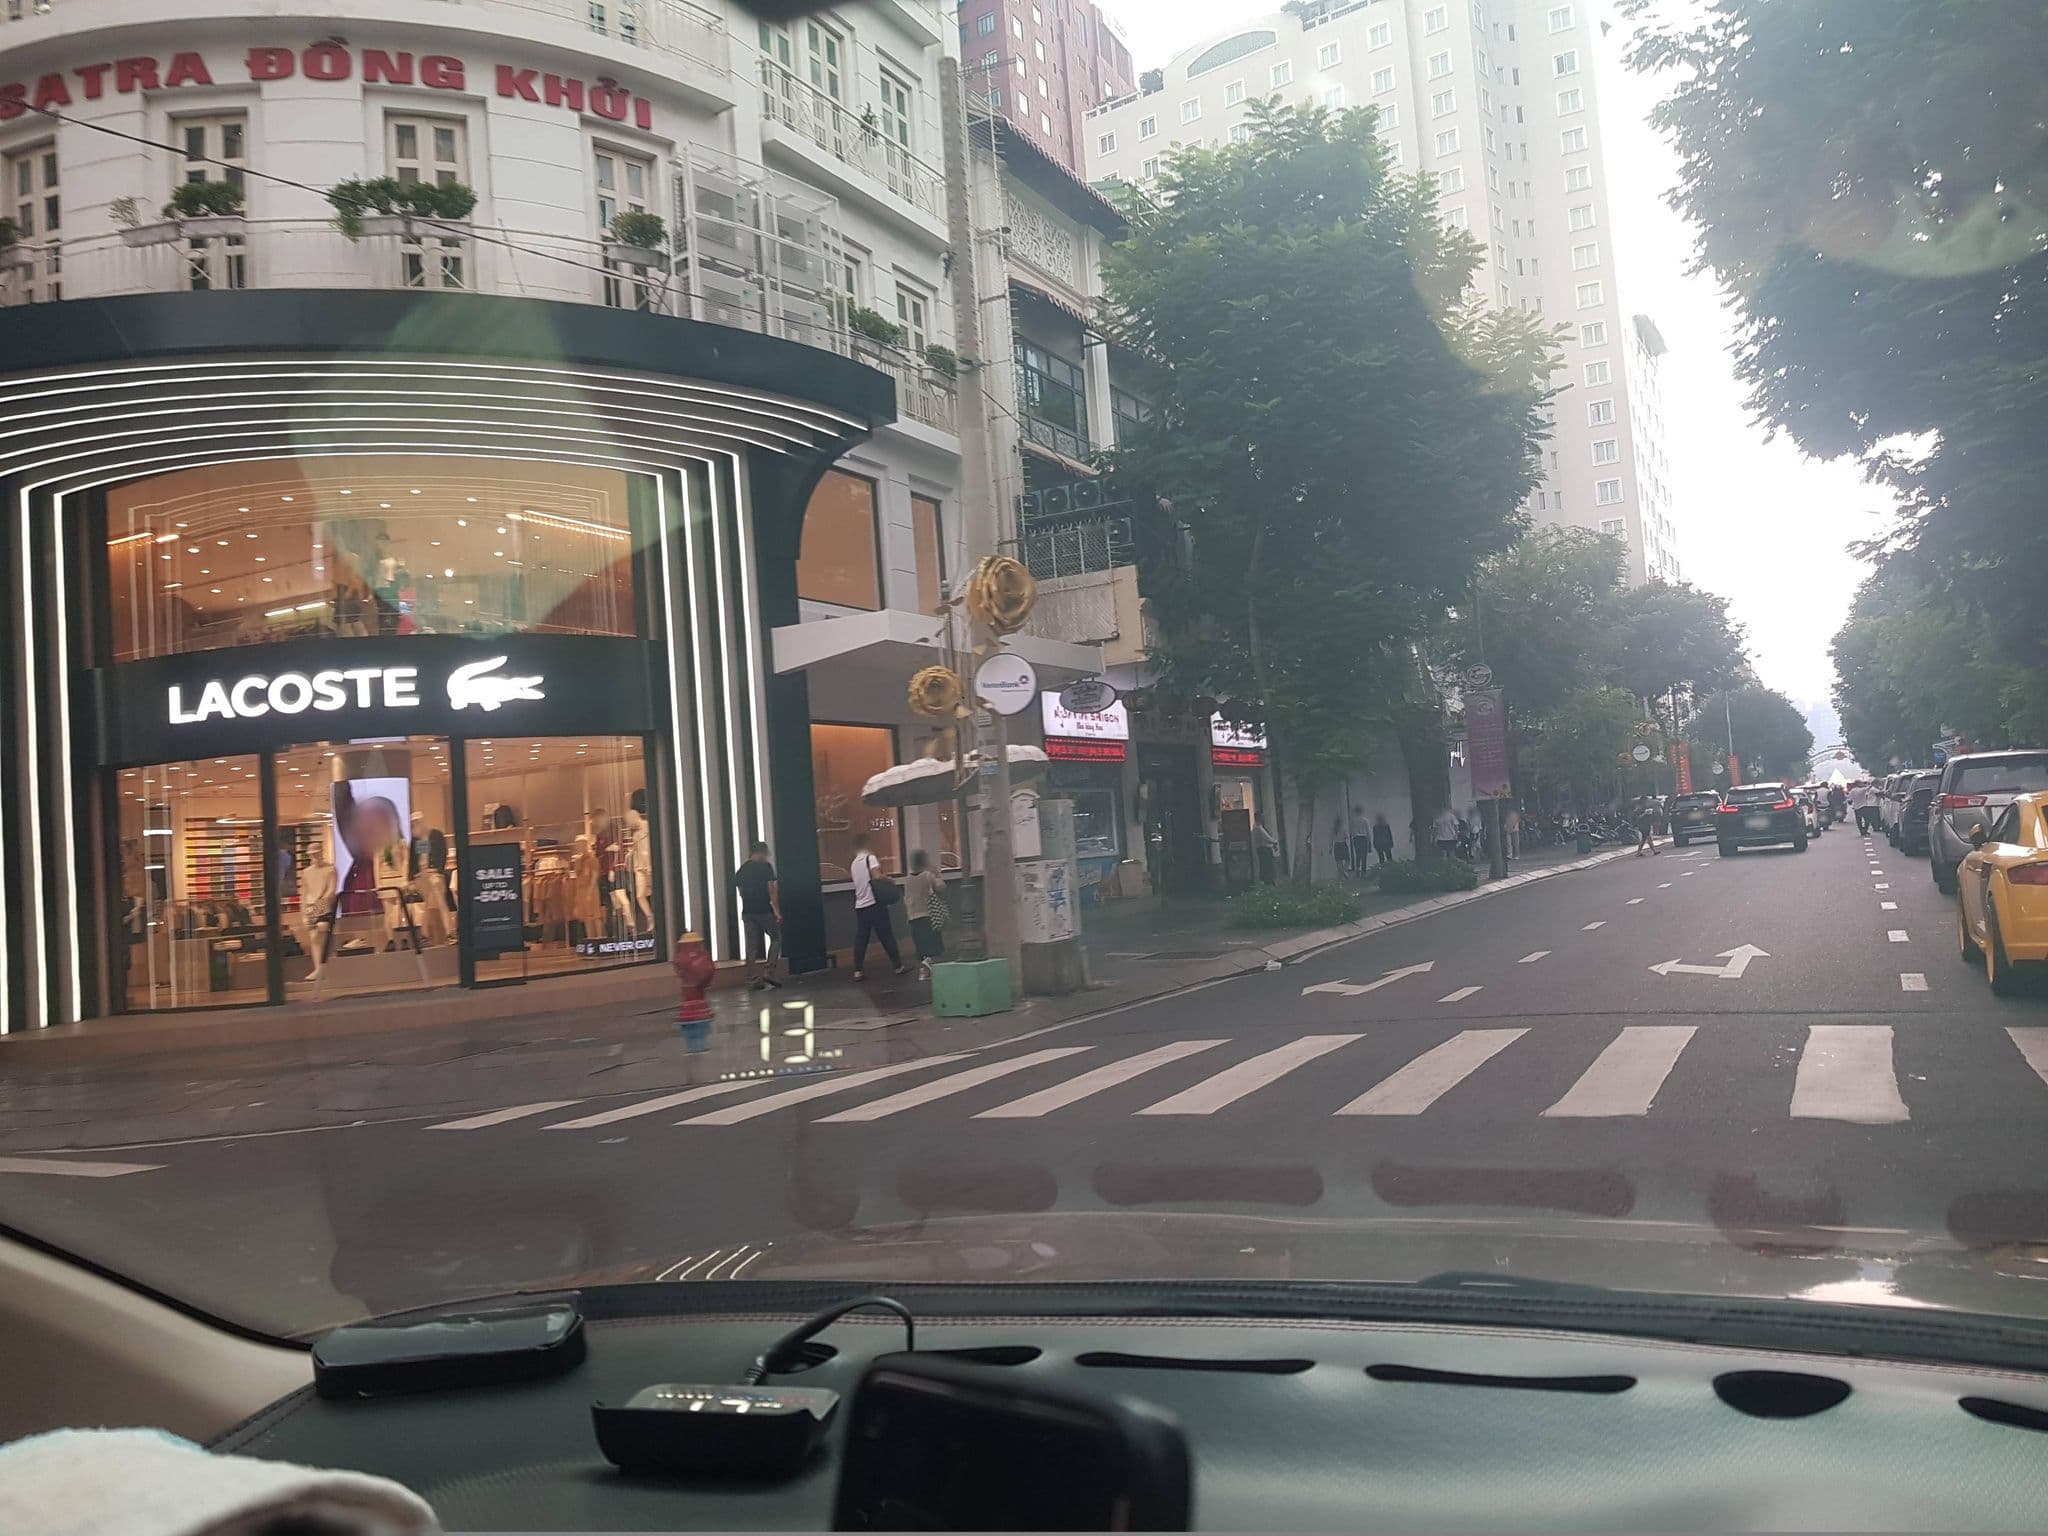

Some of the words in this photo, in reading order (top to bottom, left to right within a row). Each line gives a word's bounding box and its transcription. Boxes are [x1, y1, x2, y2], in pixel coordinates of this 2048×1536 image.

[0, 52, 214, 120] SATRA
[244, 36, 465, 91] ĐỒNG
[495, 65, 652, 130] KHỞI
[167, 667, 420, 725] LACOSTE
[475, 867, 514, 880] SALE
[599, 941, 634, 953] NEVER
[760, 1001, 814, 1063] 13
